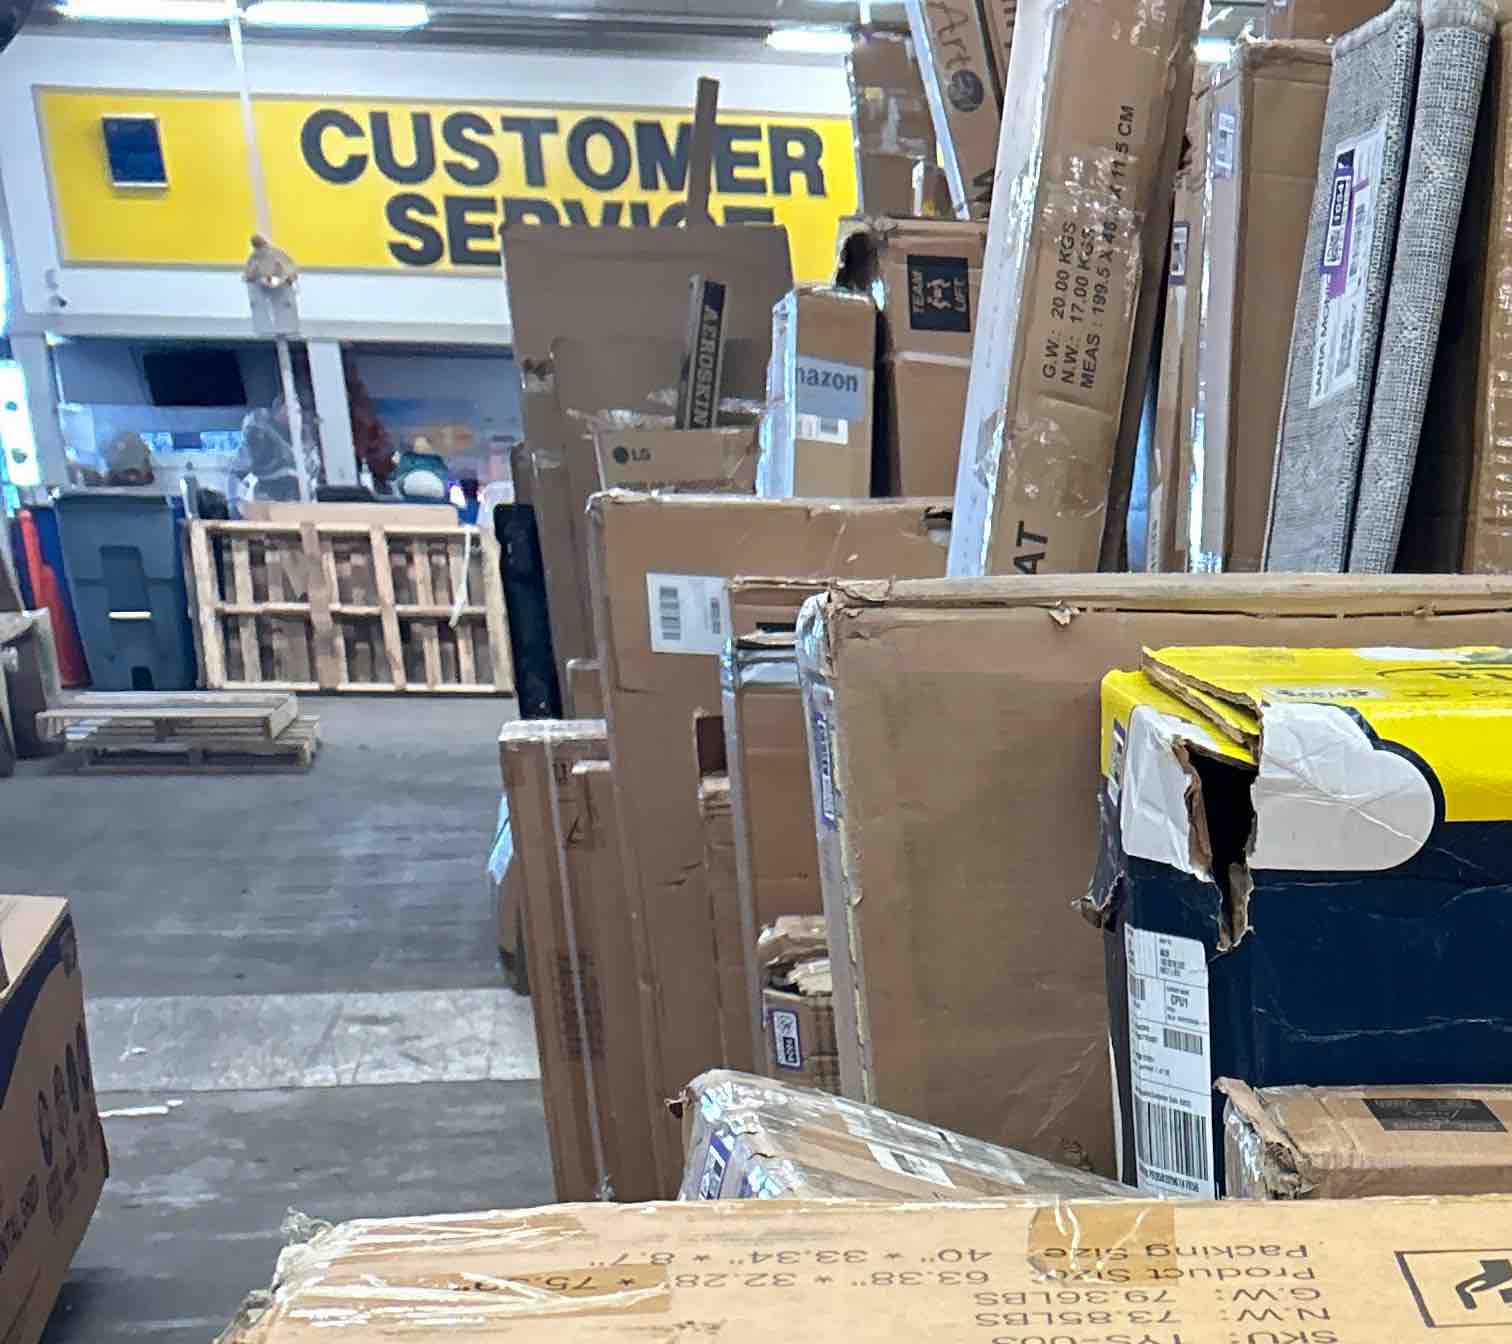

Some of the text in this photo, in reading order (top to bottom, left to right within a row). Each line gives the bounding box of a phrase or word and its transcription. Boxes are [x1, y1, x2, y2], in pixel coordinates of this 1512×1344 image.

[300, 109, 827, 198] CUSTOMER
[1092, 267, 1112, 315] 199.5
[1117, 105, 1135, 135] CM
[1060, 220, 1077, 264] KGS
[912, 271, 925, 314] TEAM
[957, 276, 968, 312] LIFT
[1071, 275, 1088, 323] 17.00
[630, 449, 652, 463] LG
[1146, 1243, 1309, 1258] Packing
[1150, 1266, 1316, 1281] Product
[973, 1289, 1177, 1307] 79.36LBS
[975, 1311, 1183, 1328] 73.85LBS
